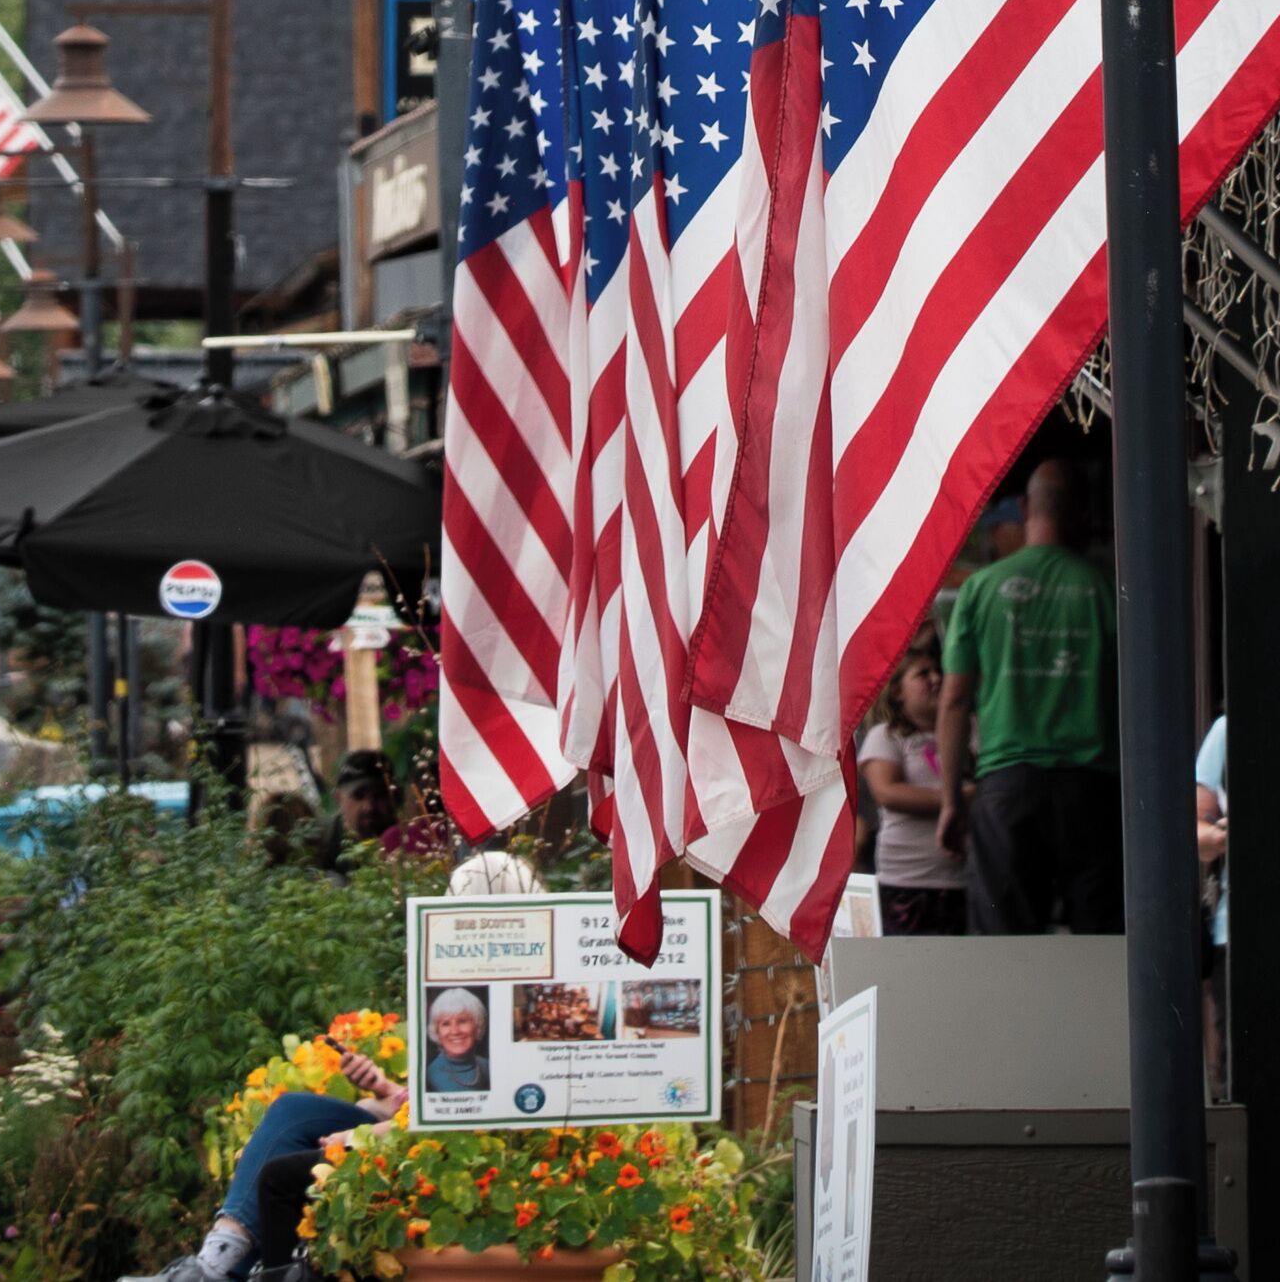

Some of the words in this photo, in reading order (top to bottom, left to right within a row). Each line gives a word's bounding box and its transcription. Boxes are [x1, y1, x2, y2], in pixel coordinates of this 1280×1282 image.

[581, 916, 609, 929] 912
[434, 941, 484, 960] INDIAN
[486, 940, 547, 963] JEWELRY
